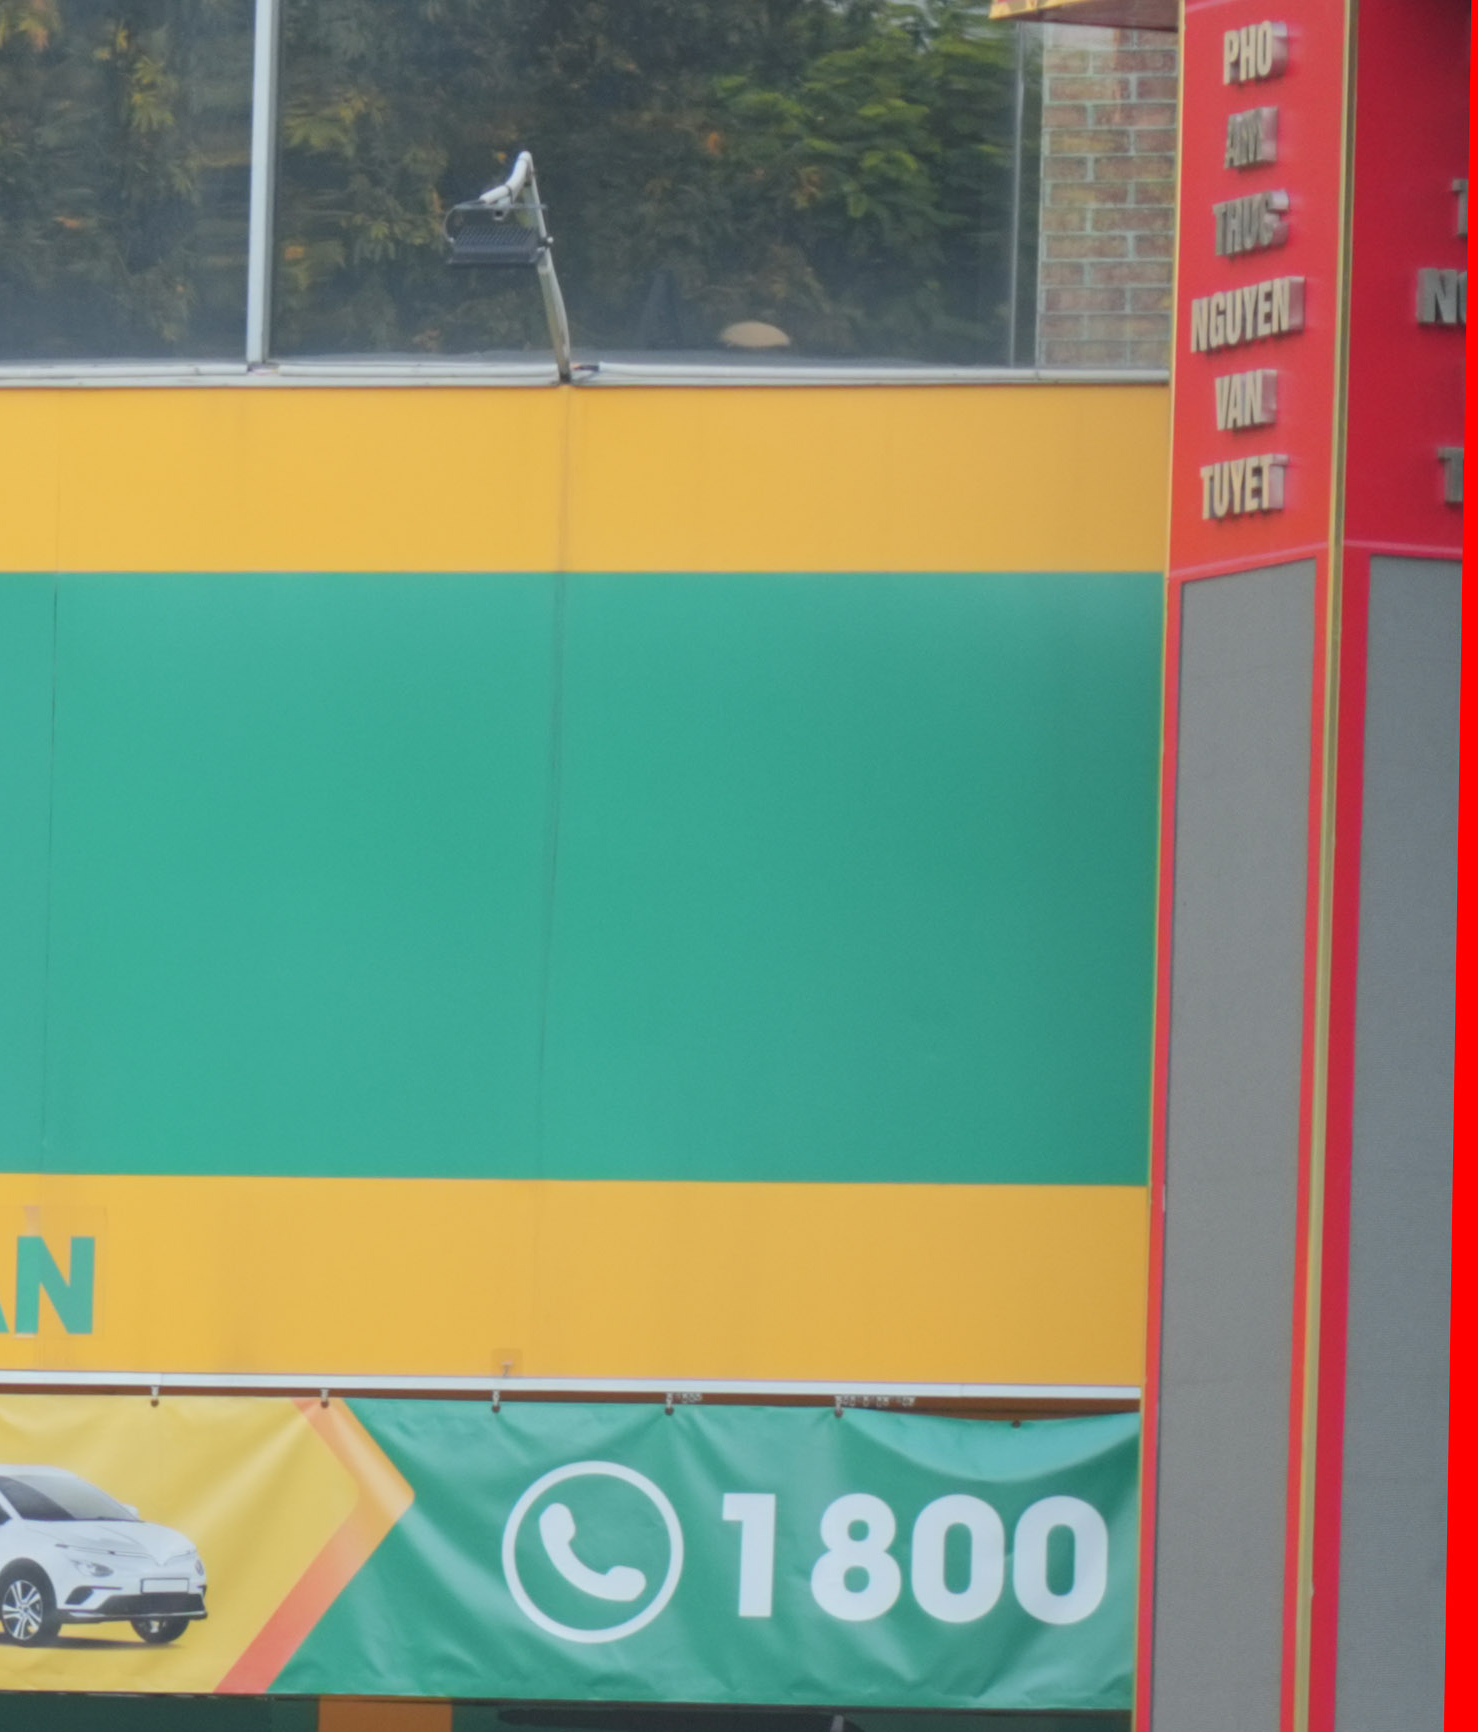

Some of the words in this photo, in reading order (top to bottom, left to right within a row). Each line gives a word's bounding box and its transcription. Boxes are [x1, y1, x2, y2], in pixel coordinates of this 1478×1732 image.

[1224, 21, 1286, 84] PHO
[1191, 276, 1304, 352] NGUYEN
[1216, 370, 1276, 430] VAN
[1201, 454, 1287, 520] TUYET
[722, 1492, 1109, 1626] 1800
